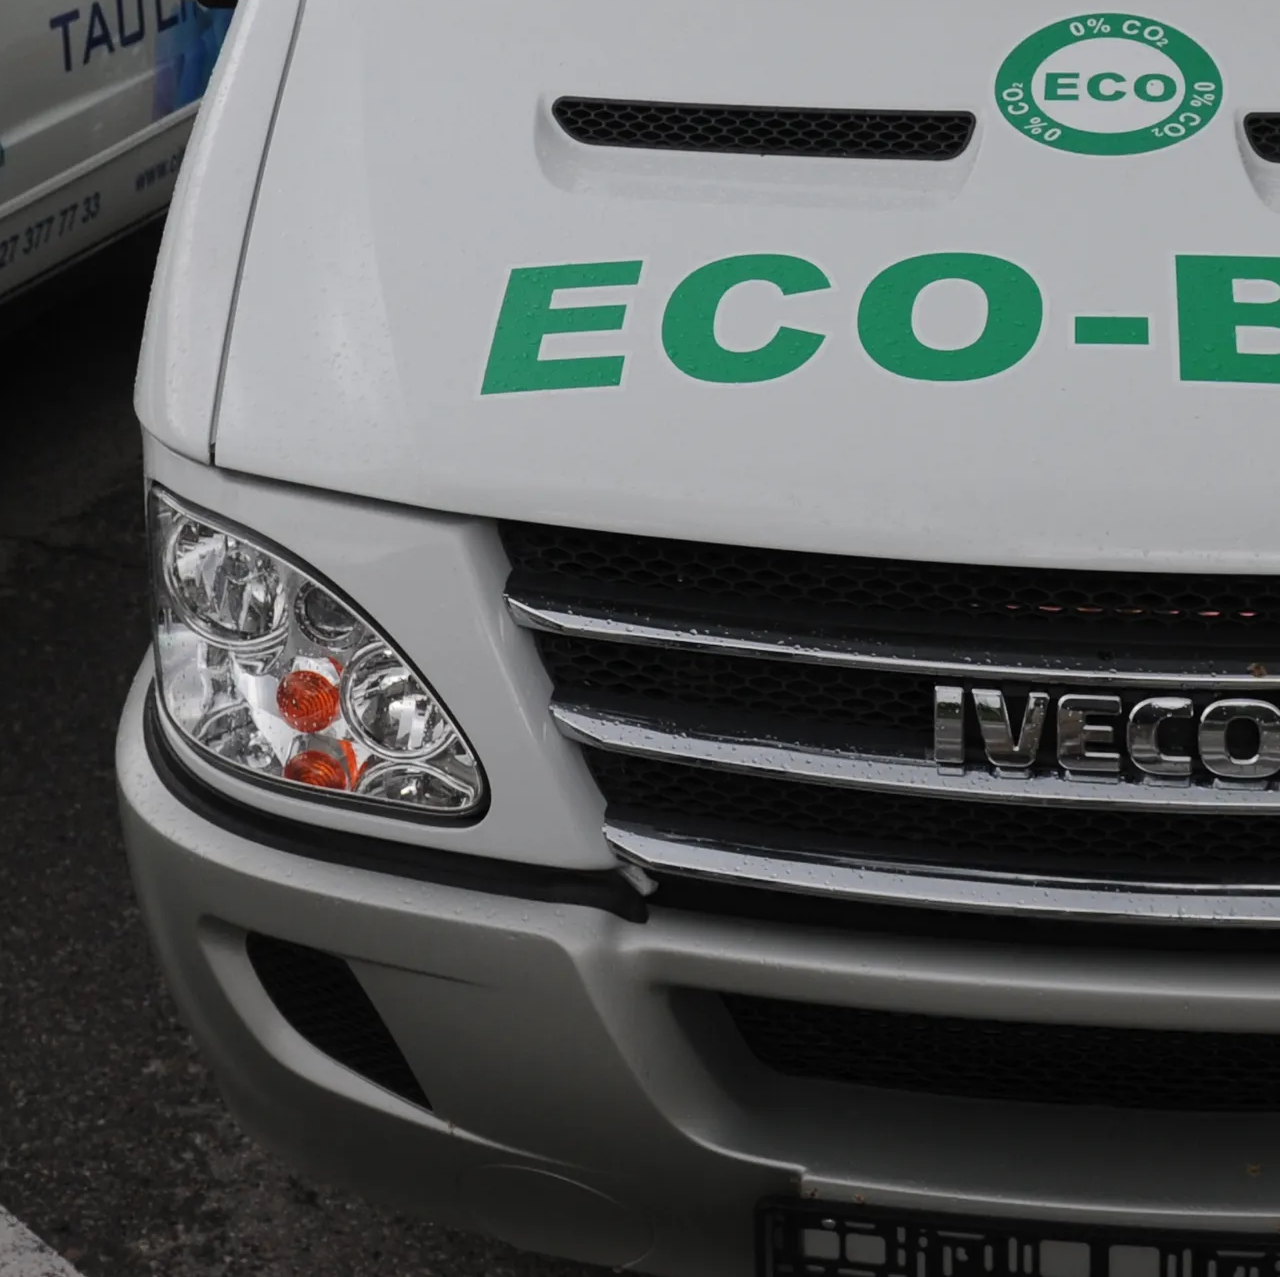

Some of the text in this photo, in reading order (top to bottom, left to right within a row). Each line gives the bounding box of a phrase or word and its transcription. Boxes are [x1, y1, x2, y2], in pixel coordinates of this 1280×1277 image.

[1044, 72, 1177, 102] ECO
[22, 214, 55, 255] 377
[59, 203, 79, 238] 77
[81, 191, 102, 224] 33
